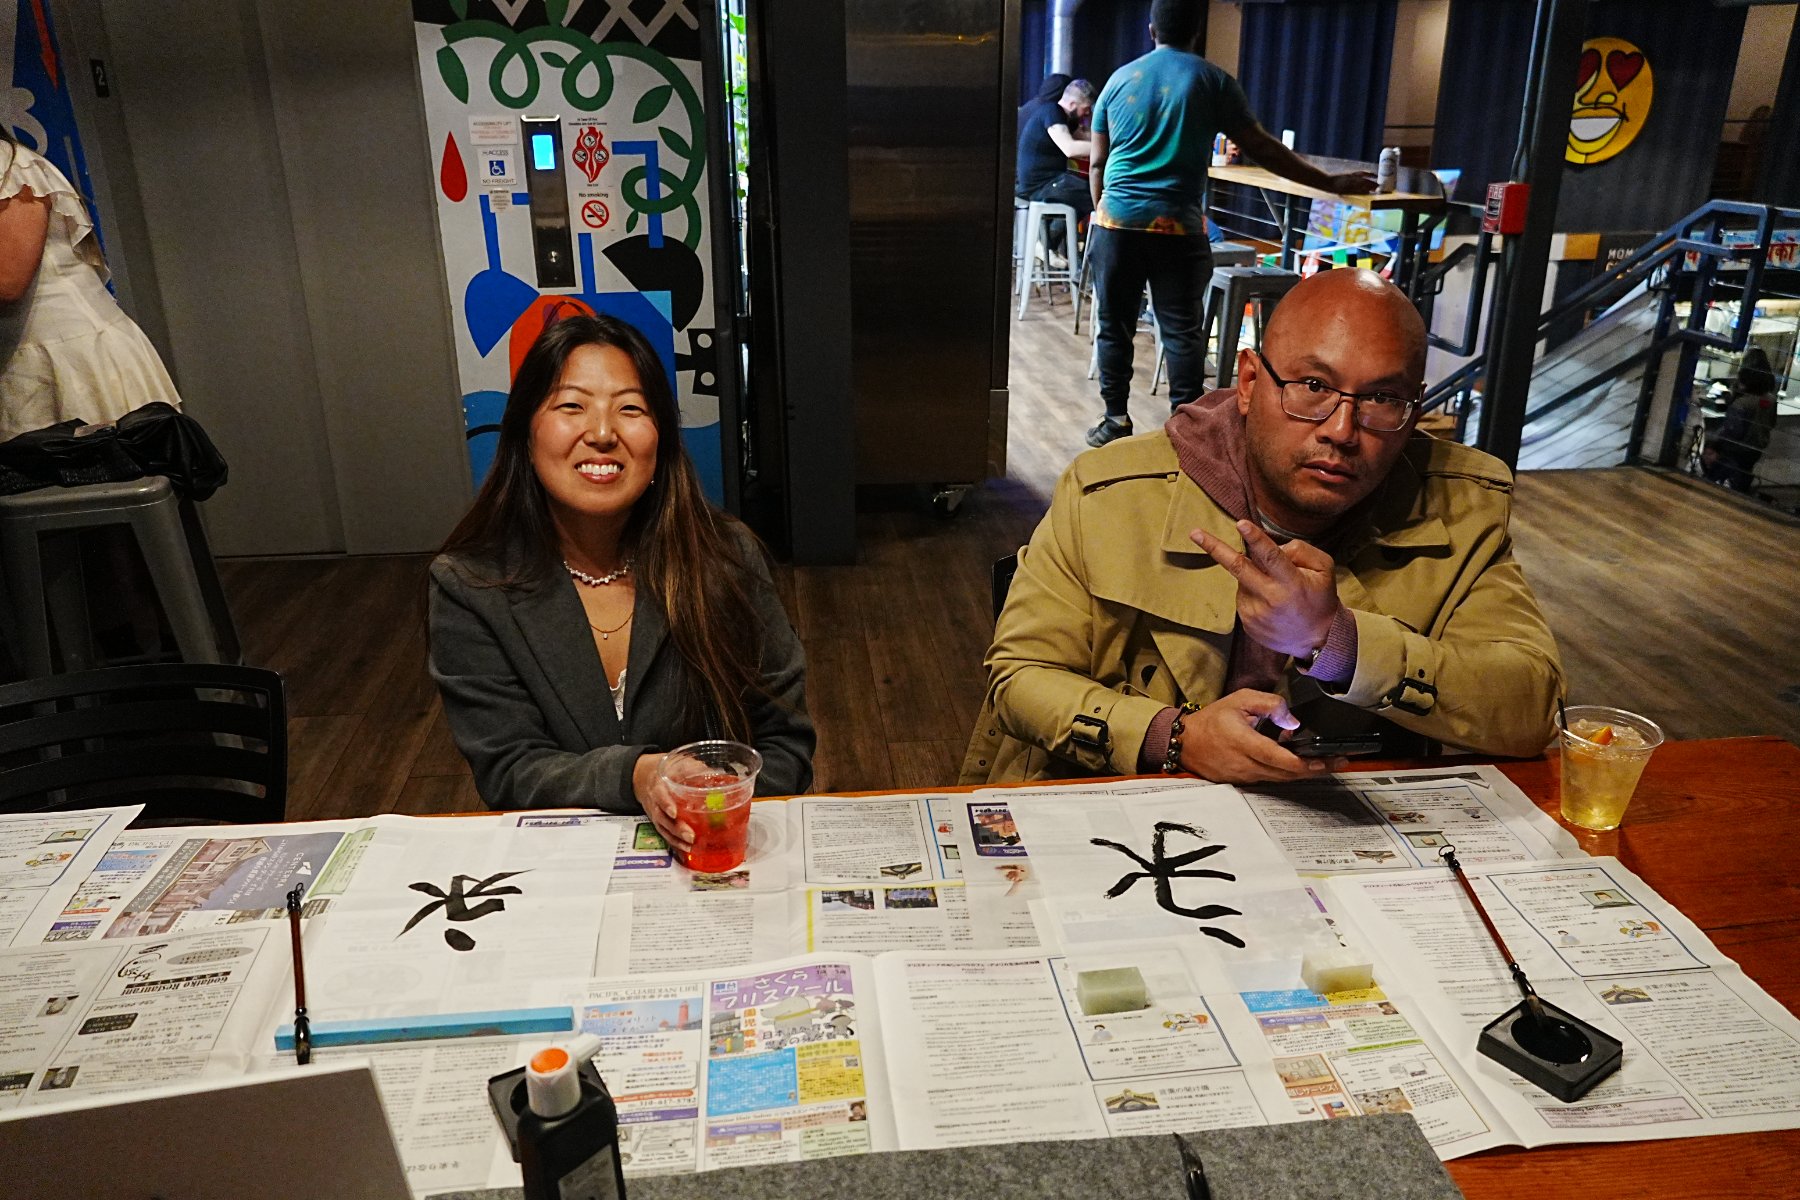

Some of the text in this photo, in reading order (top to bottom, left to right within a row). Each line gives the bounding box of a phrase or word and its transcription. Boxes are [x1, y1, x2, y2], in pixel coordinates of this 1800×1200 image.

[96, 65, 106, 86] 2
[754, 970, 808, 989] さくら
[589, 984, 699, 999] PACIFIC GUARDIAN LIFE
